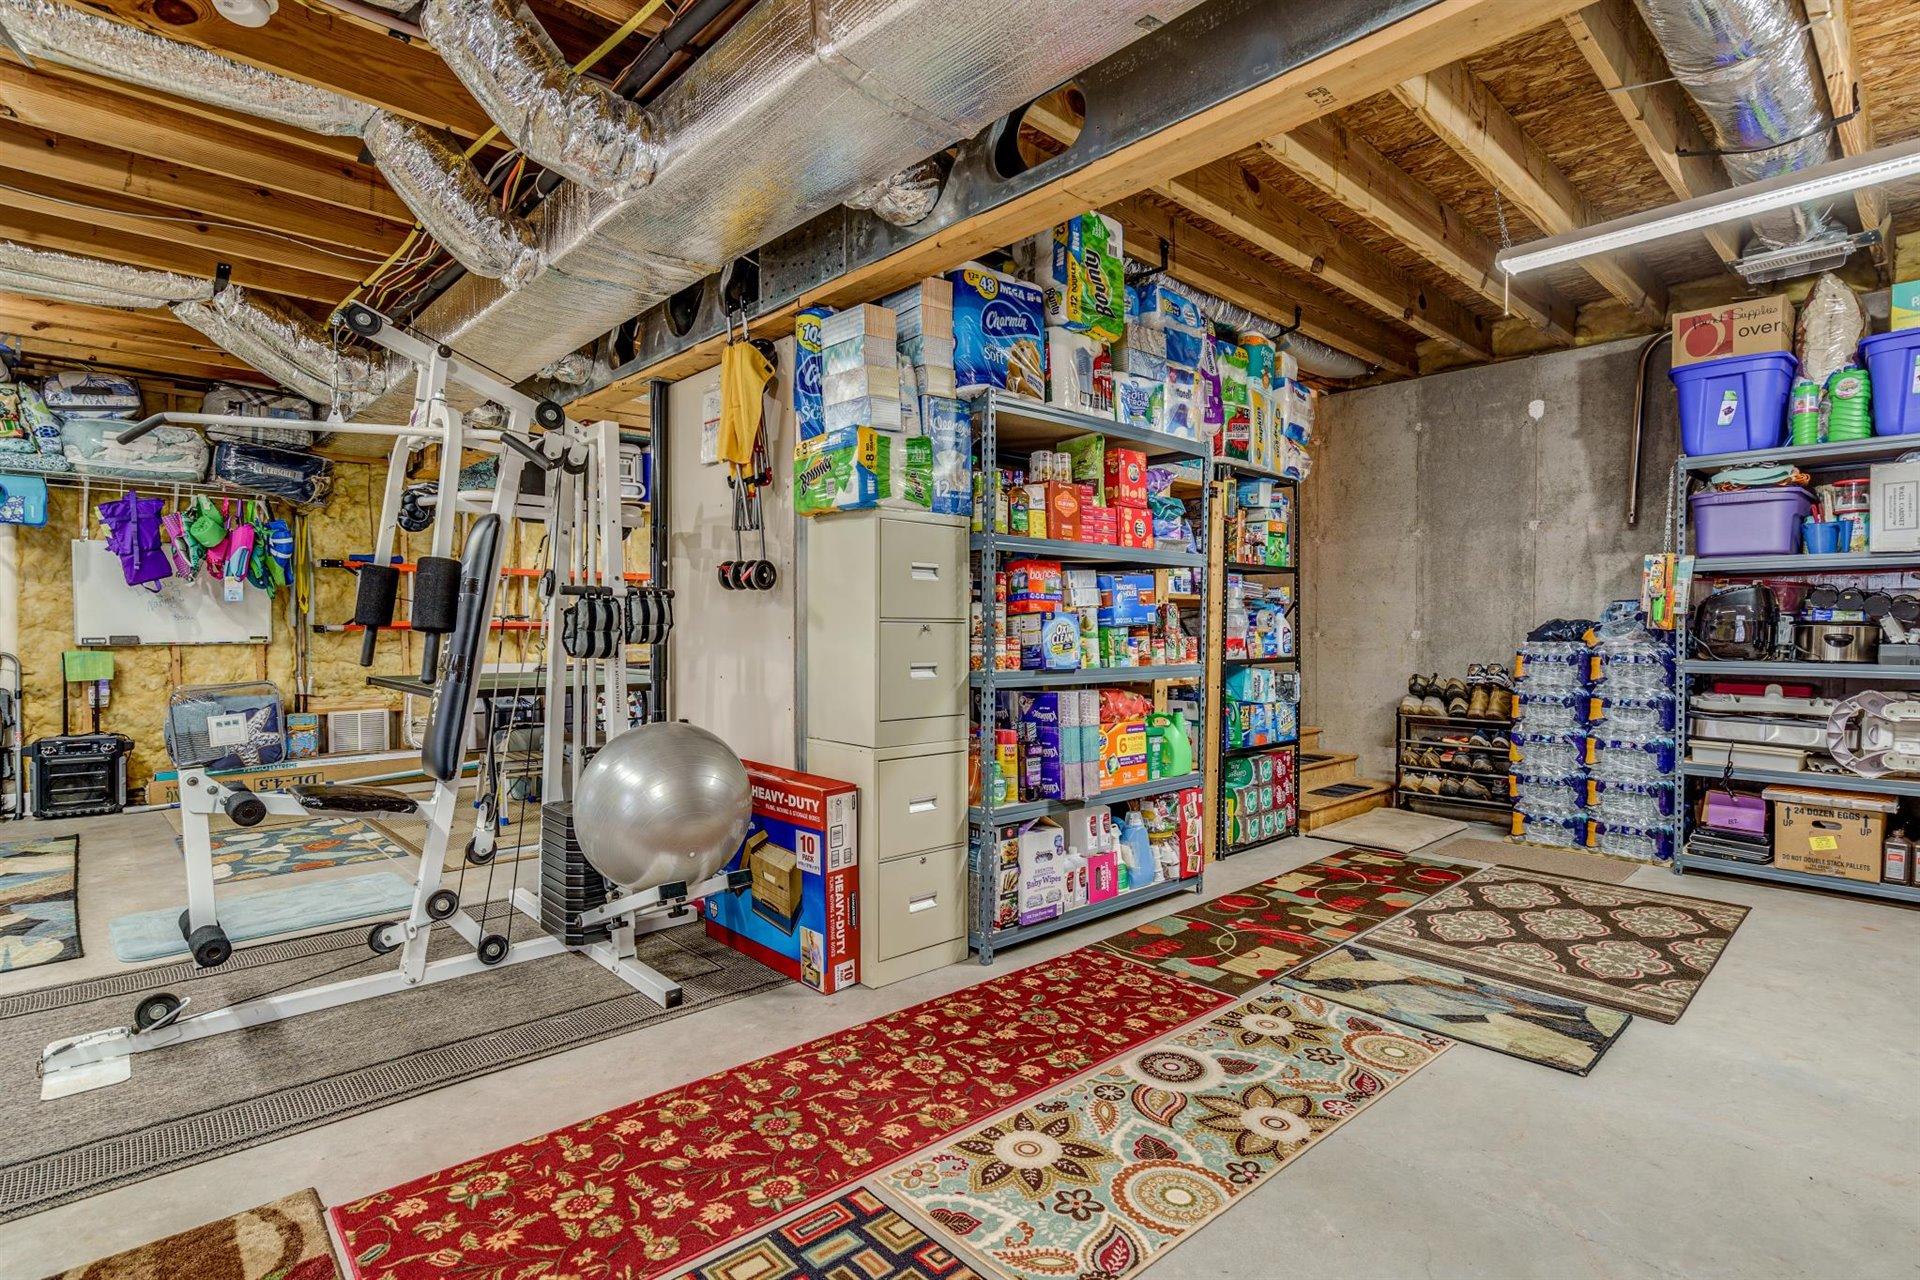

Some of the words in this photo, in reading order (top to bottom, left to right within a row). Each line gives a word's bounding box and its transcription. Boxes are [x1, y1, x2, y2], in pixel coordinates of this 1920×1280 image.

[980, 276, 995, 292] 48
[1085, 248, 1116, 320] Bounty
[1044, 287, 1060, 316] Bounty
[986, 311, 1028, 331] Charmin
[799, 454, 832, 497] Bounty
[936, 480, 950, 497] 12
[1029, 569, 1056, 582] bounce
[1056, 624, 1069, 635] OXI
[1051, 632, 1074, 645] CLEAN
[1119, 738, 1128, 753] 6
[259, 774, 317, 790] DL-4.5
[751, 785, 820, 812] HEAVY-DUTY
[1794, 806, 1804, 815] 24
[1807, 807, 1835, 818] DOZEN
[1837, 811, 1861, 821] EGGS
[1783, 819, 1793, 827] UP
[1860, 828, 1872, 836] UP
[800, 835, 814, 855] 10
[802, 854, 814, 863] PACK
[1791, 854, 1802, 862] NOT
[1803, 857, 1825, 865] DOUBLE
[1826, 859, 1844, 868] STACK
[1846, 861, 1871, 871] PALLETS
[1026, 878, 1041, 890] Baby
[1042, 874, 1061, 886] Wipes
[835, 874, 845, 955] HEAVY-DUTY
[844, 965, 853, 980] 10
